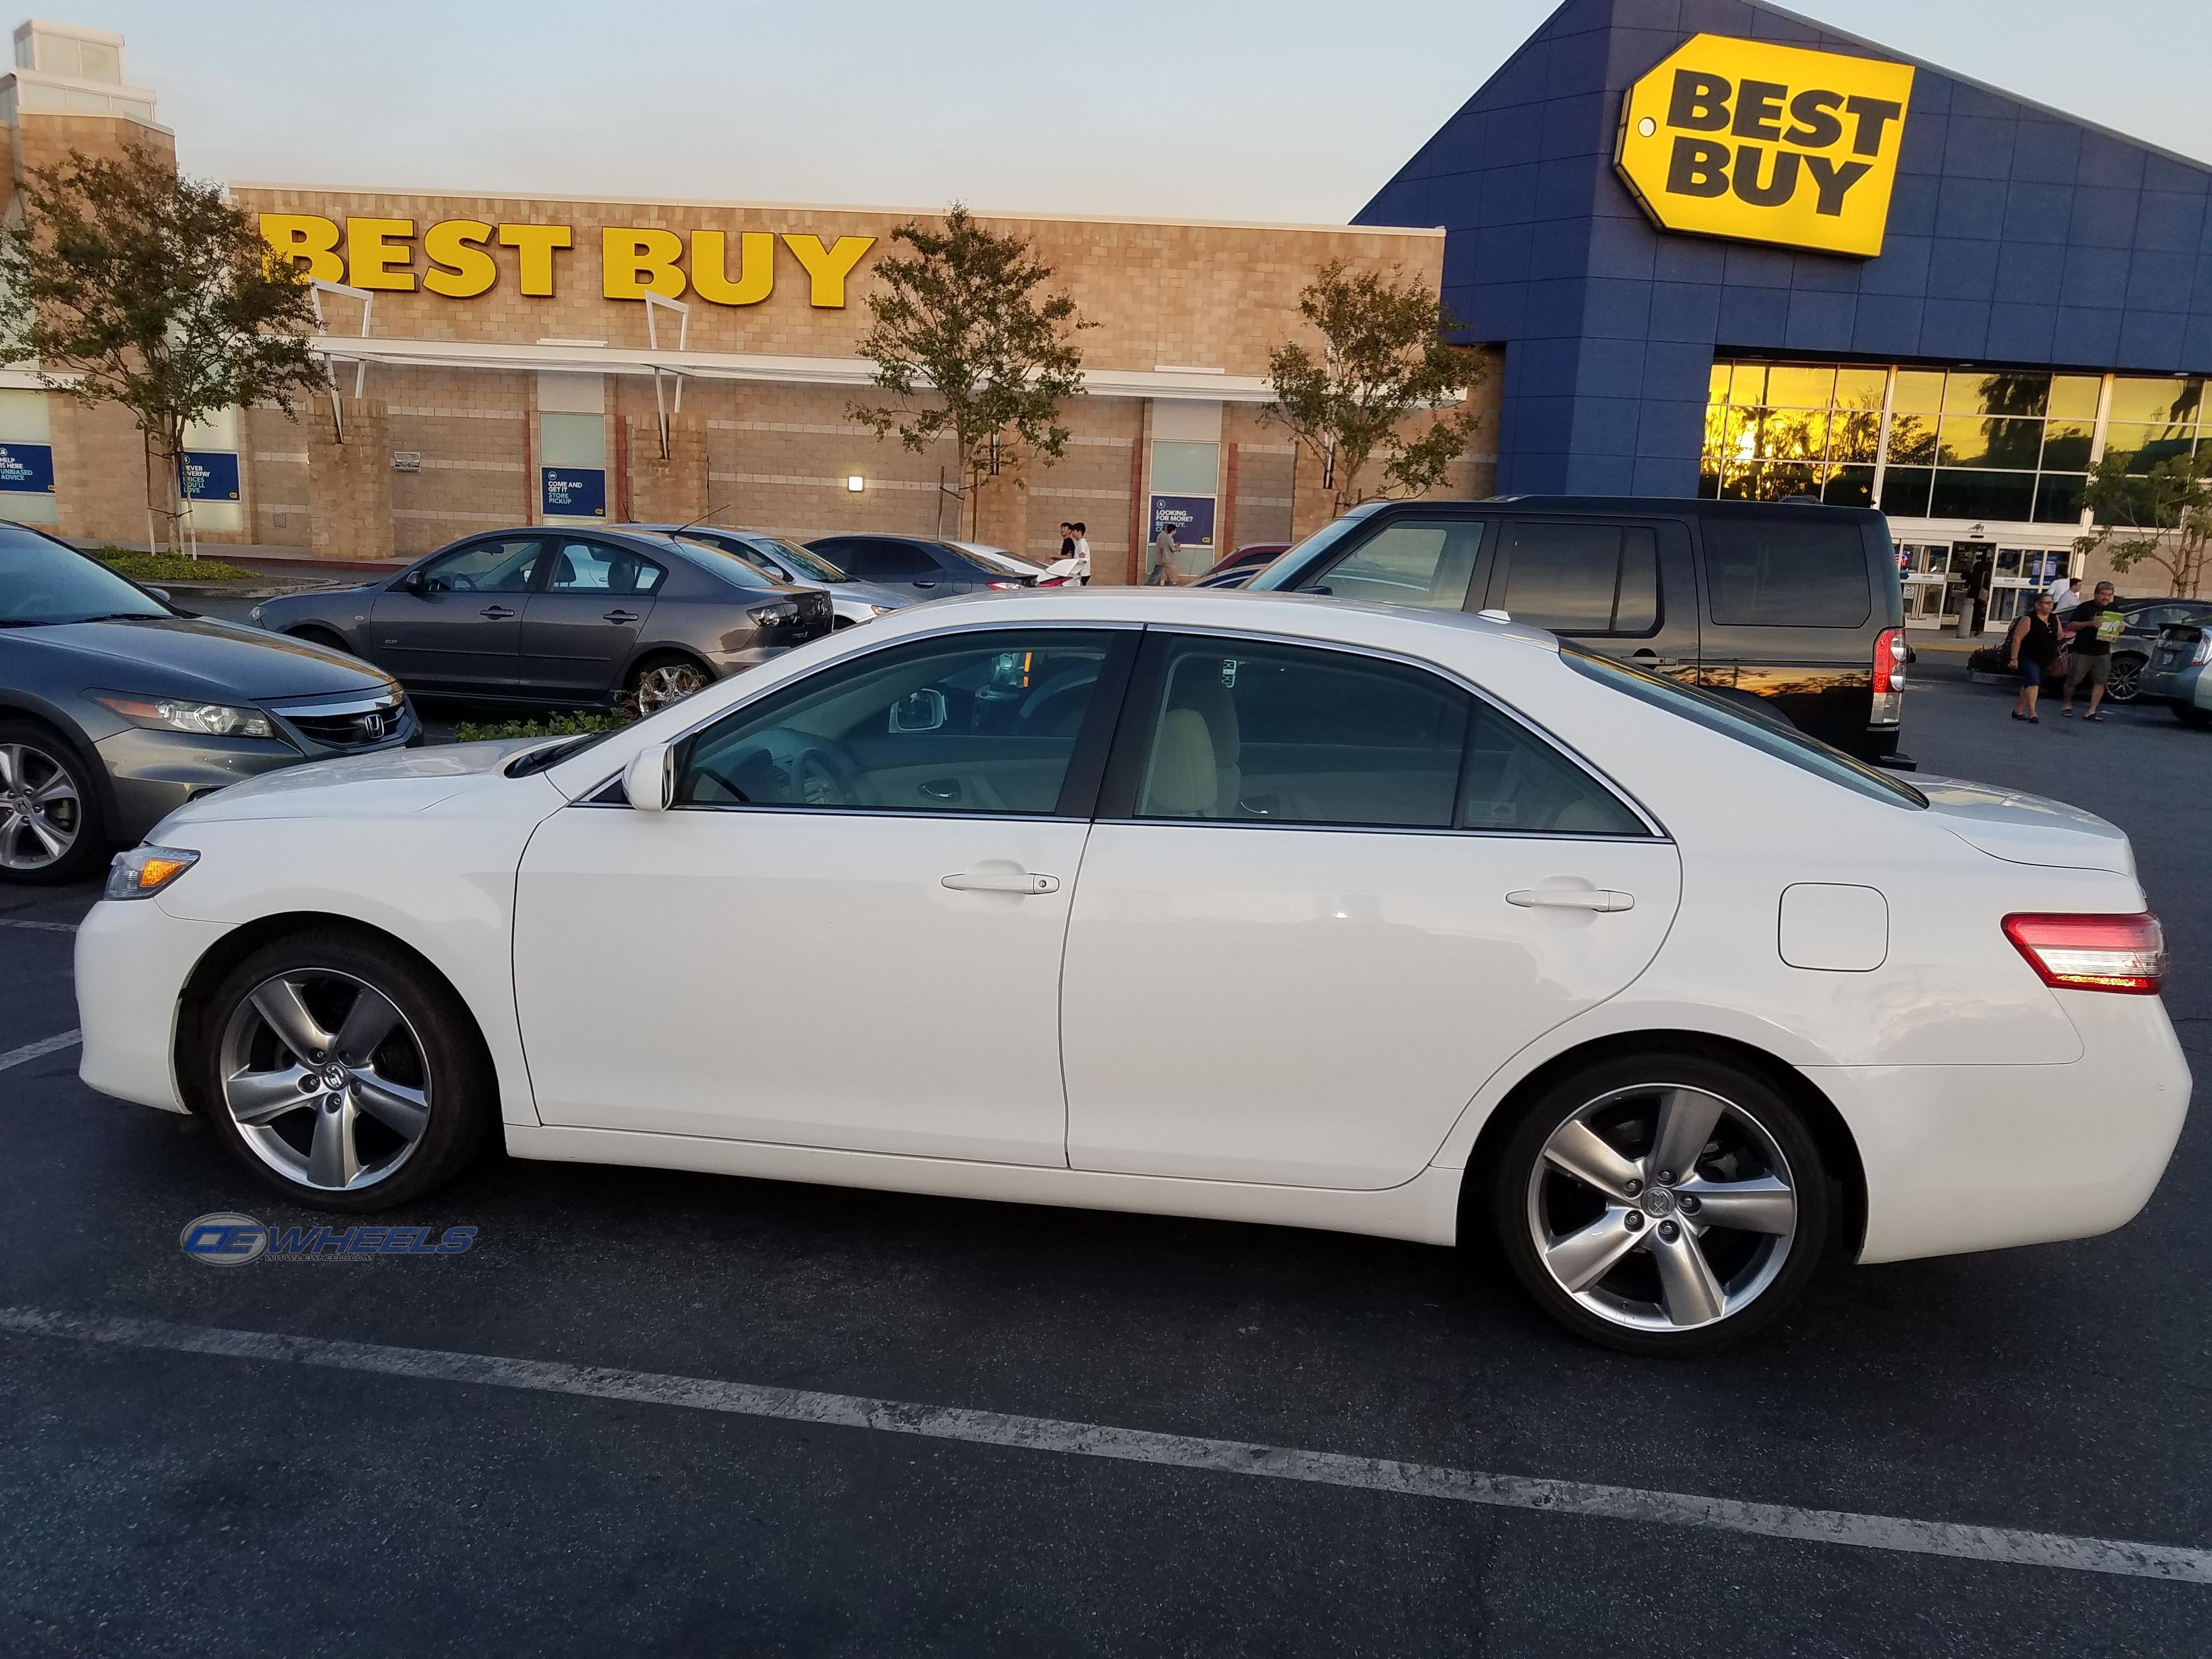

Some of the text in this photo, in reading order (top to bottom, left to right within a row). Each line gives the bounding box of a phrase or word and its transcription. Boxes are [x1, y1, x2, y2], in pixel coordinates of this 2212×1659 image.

[1666, 68, 1903, 157] BEST
[1665, 136, 1874, 217] BUY
[258, 212, 879, 309] BEST BUY
